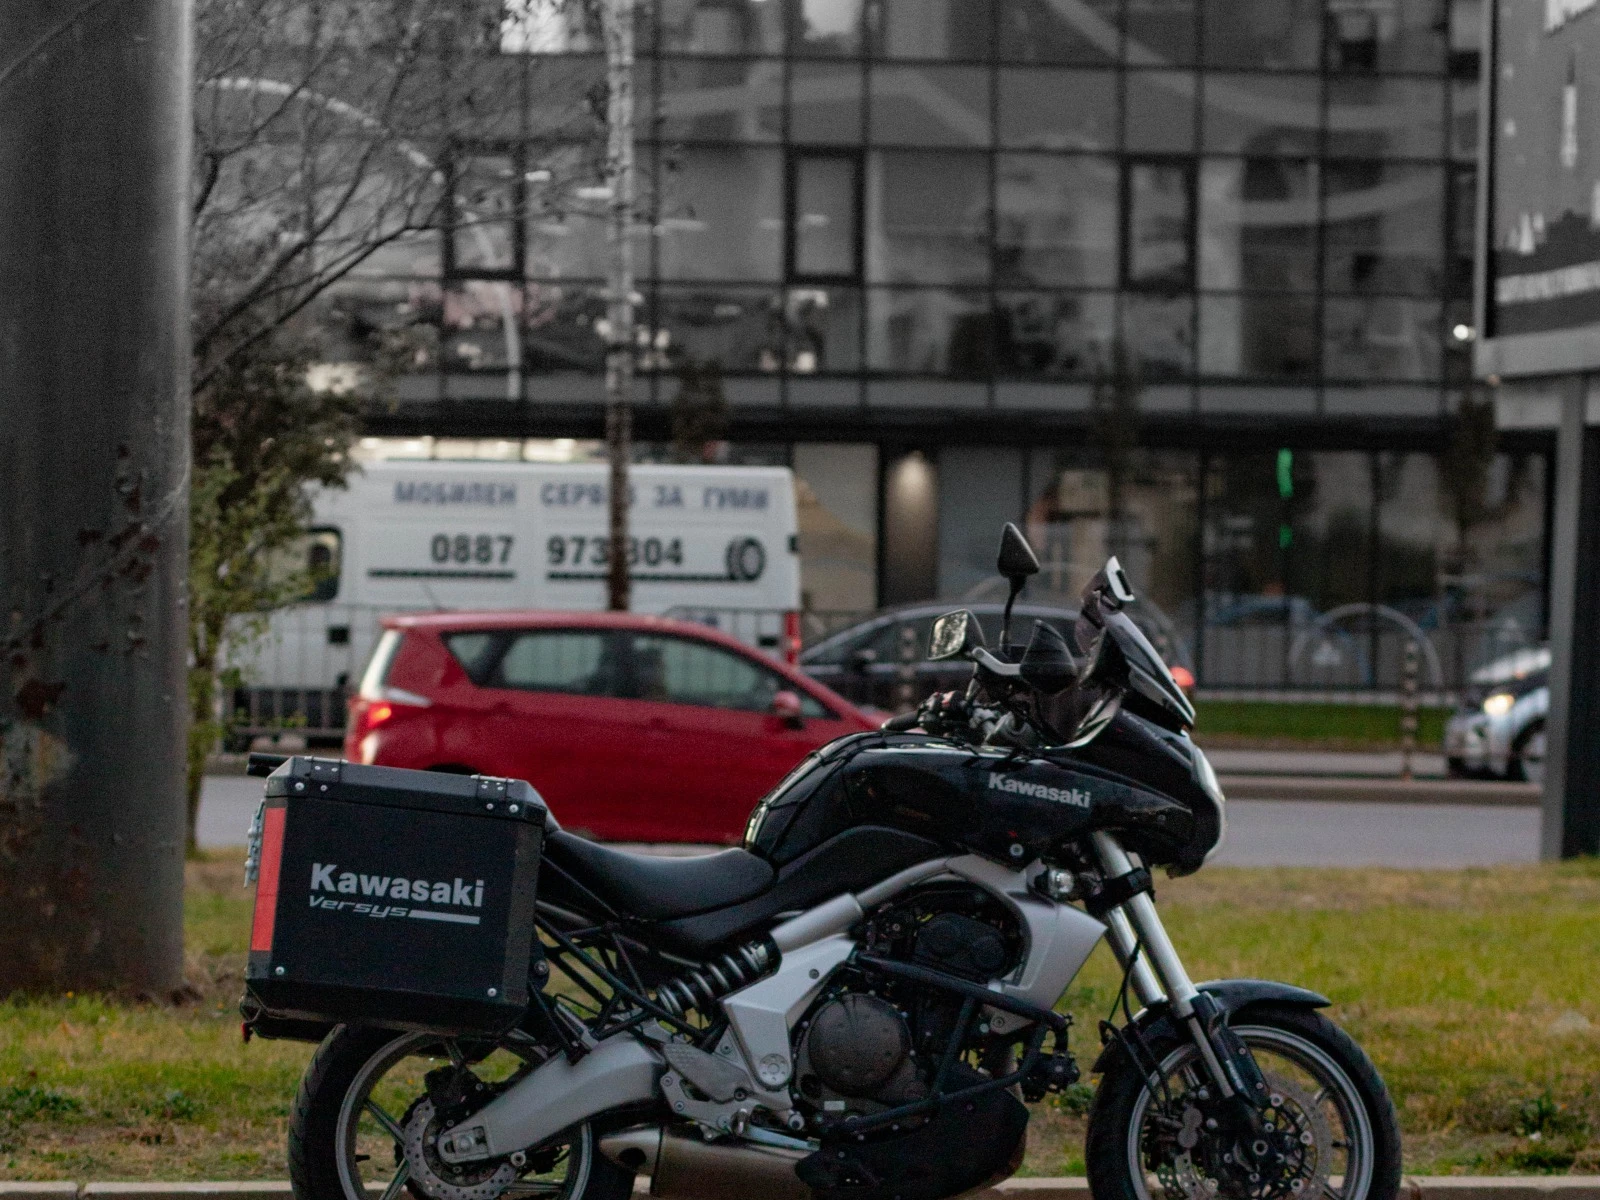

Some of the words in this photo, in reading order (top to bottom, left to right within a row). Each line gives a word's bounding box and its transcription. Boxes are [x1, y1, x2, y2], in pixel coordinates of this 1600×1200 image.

[540, 482, 637, 507] СЕРВ
[431, 533, 514, 564] 0887
[988, 772, 1091, 808] Kawasaki
[310, 862, 485, 907] Kawasaki
[309, 895, 409, 919] Versys
